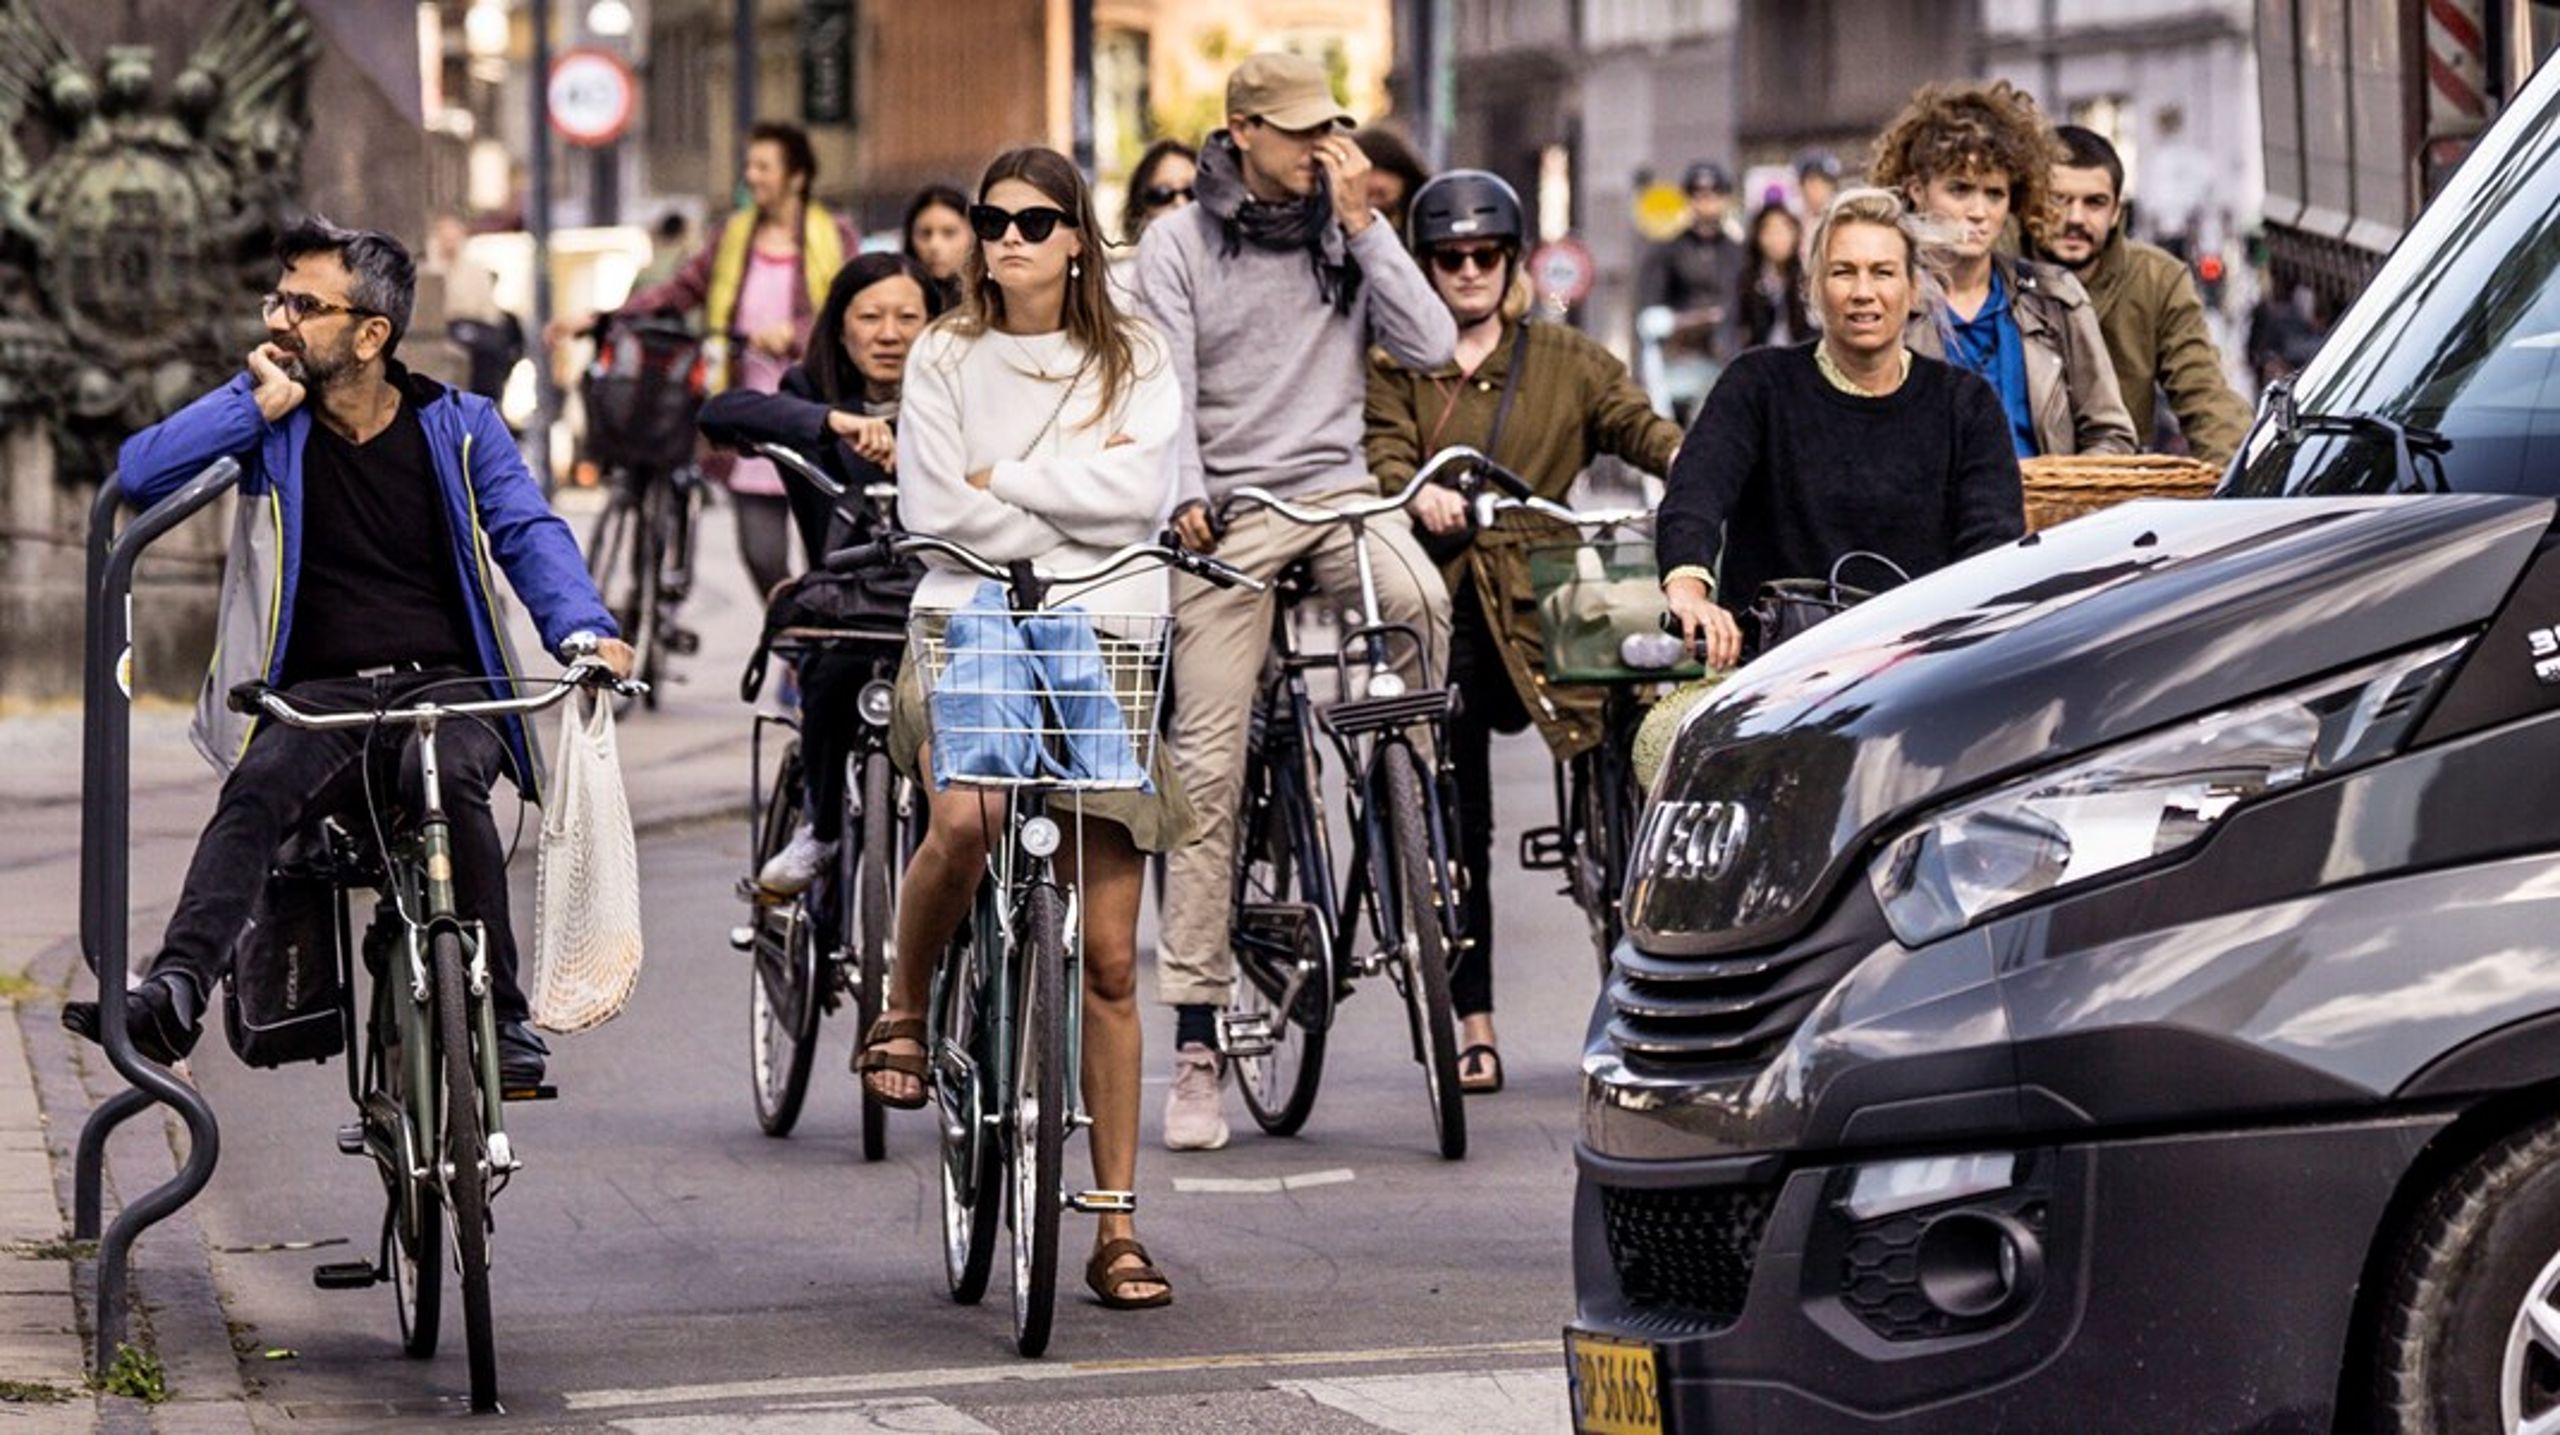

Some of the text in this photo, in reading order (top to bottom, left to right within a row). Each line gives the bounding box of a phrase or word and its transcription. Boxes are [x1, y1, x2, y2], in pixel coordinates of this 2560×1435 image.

[2528, 624, 2560, 656] 3
[1637, 801, 1750, 880] IVECO
[1598, 1354, 1622, 1424] 56
